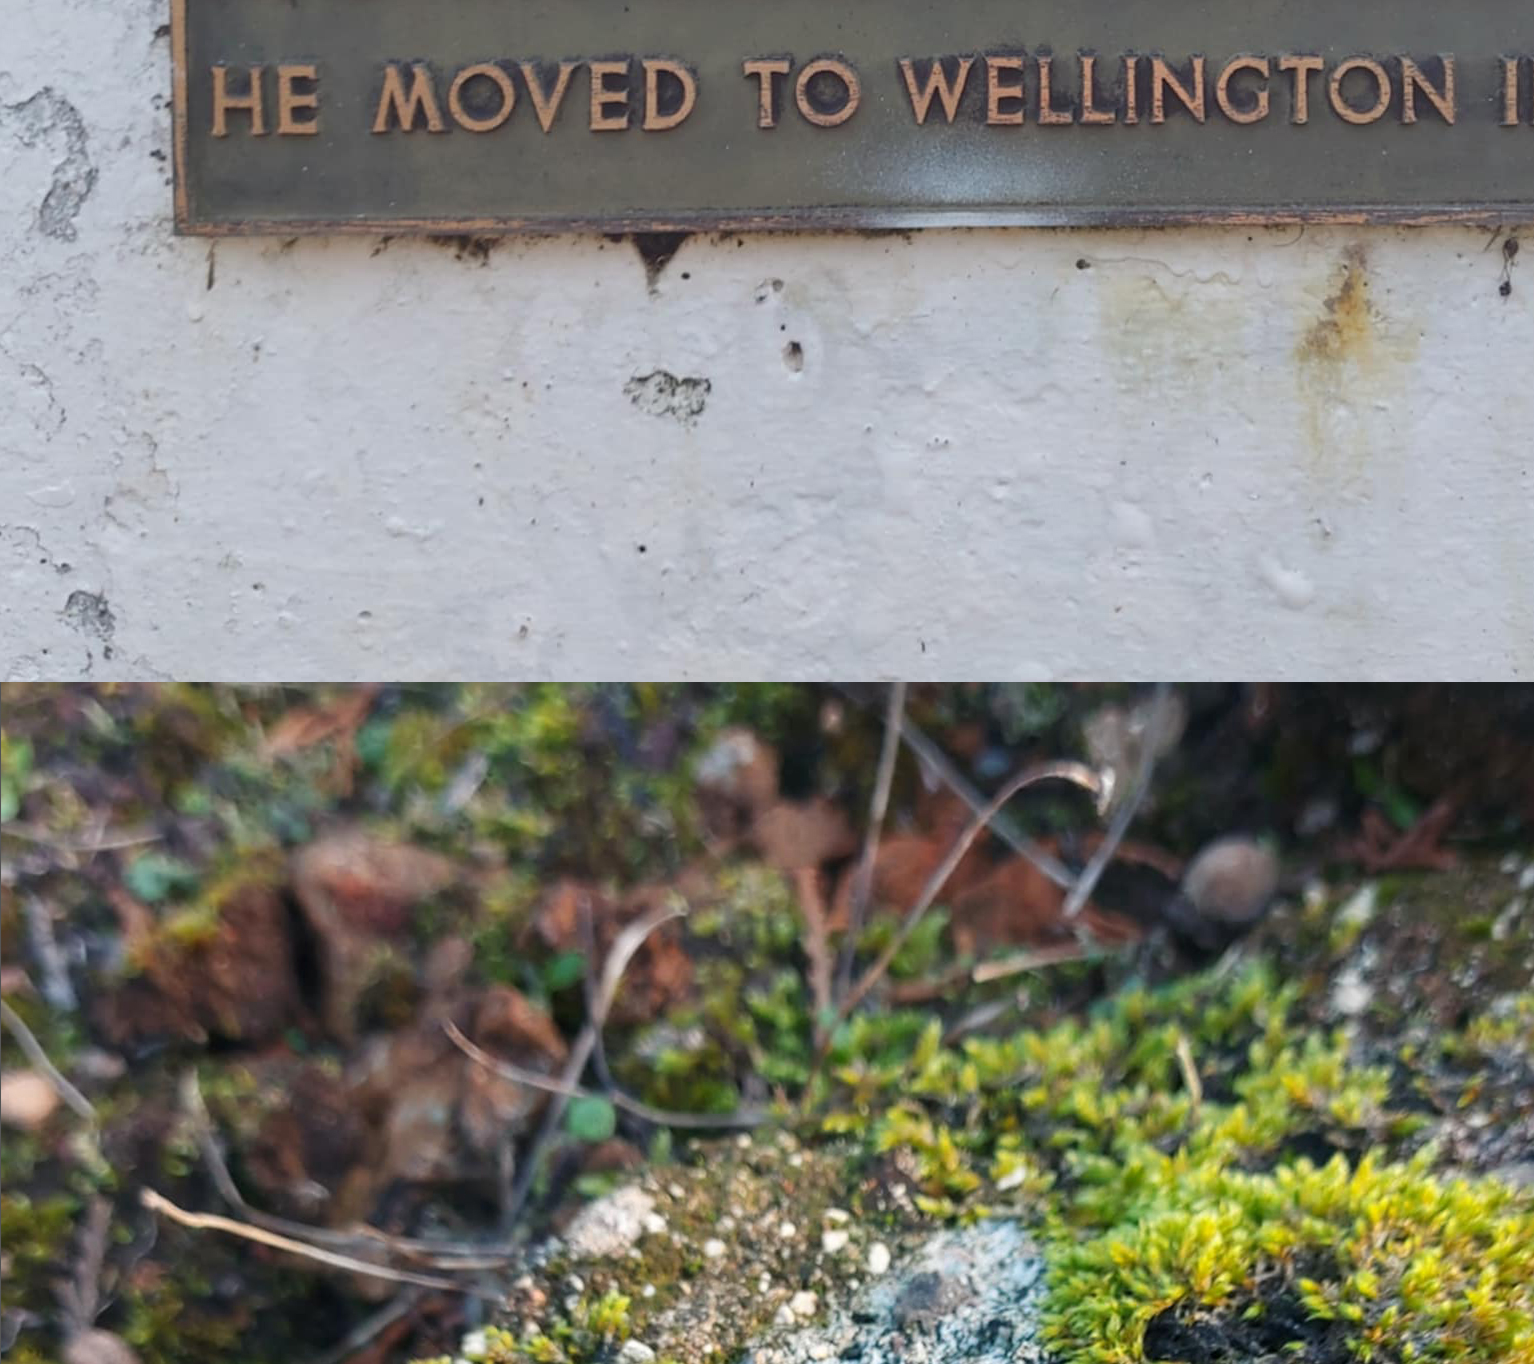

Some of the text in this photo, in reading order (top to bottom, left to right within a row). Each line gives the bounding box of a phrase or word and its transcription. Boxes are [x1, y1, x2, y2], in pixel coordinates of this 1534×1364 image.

[210, 64, 318, 137] HE
[372, 59, 696, 132] MOVED
[743, 59, 860, 127] TO
[900, 54, 1456, 124] WELLINGTON
